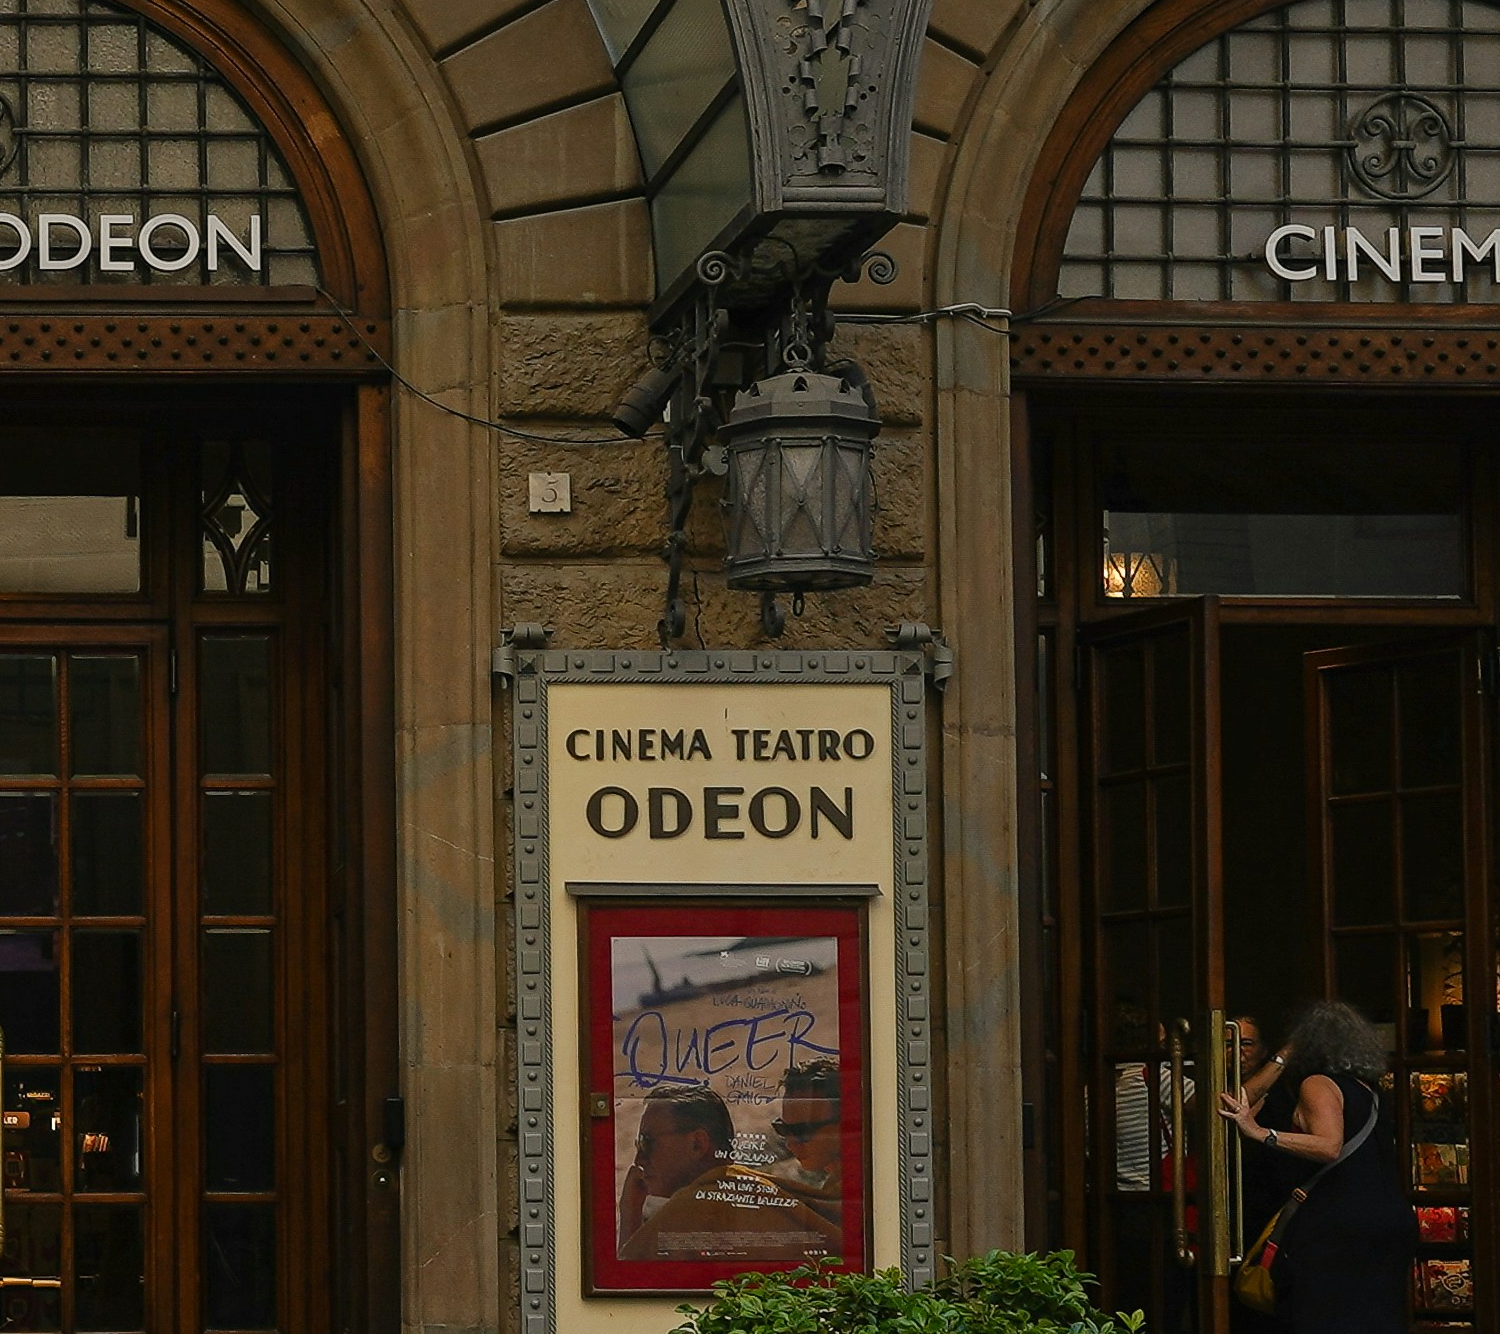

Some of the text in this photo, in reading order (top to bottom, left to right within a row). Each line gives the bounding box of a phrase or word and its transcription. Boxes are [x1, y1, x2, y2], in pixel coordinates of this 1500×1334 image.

[541, 479, 558, 504] 5
[566, 728, 875, 762] CINEMA TEATRO
[585, 785, 854, 840] ODEON
[614, 1009, 840, 1088] QUEER
[725, 1072, 776, 1090] DANIEL
